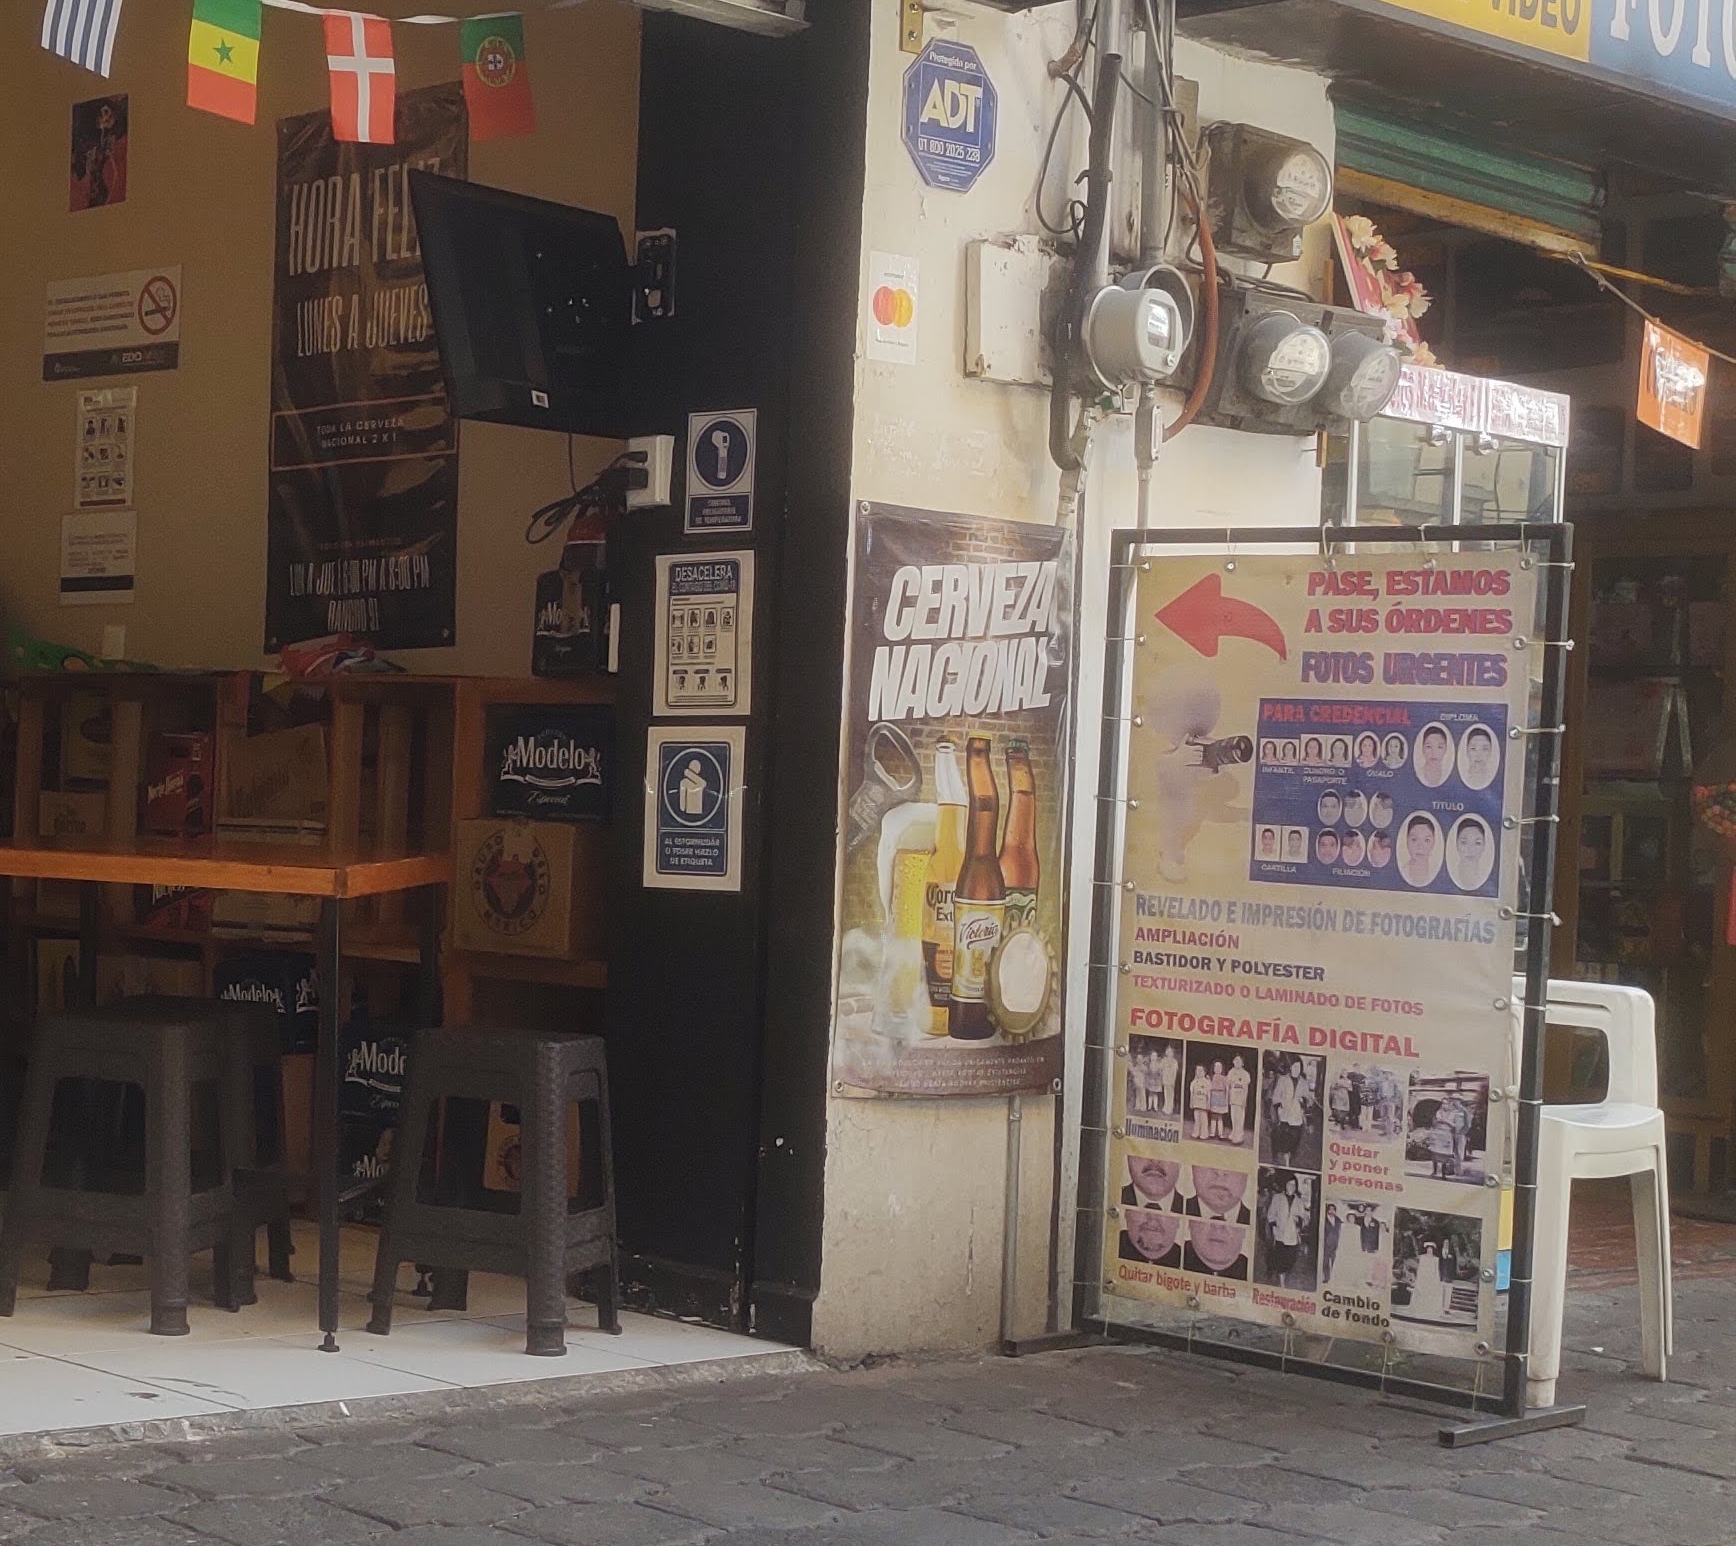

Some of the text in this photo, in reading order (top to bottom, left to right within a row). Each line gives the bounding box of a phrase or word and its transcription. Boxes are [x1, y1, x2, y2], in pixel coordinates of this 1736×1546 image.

[920, 77, 982, 133] ADT
[289, 156, 441, 277] HORA FEL
[297, 283, 429, 358] LUNES A JUEVES
[675, 564, 733, 581] DESACELERA
[1307, 569, 1511, 601] PASE, ESTAMOS
[883, 561, 1059, 642] CERVEZA
[1304, 602, 1513, 634] A SUS ÓRDENES
[868, 636, 1052, 722] NACIONAL
[1300, 651, 1508, 687] FOTOS URGENTES
[1264, 704, 1305, 723] PARA
[516, 736, 585, 771] Modelo
[1135, 893, 1496, 945] REVELADO E IMPRESIÓN DE FOTOGRAFÍAS
[1134, 926, 1240, 950] AMPLIACIÓN
[1133, 950, 1325, 982] BASTIDOR Y POLYESTER
[1132, 974, 1424, 1016] TEXTURIZADO O LAMINADO DE FOTOS
[1129, 1007, 1419, 1058] FOTOGRAFÍA DIGITAL
[1329, 1142, 1380, 1159] Quitar
[1327, 1173, 1404, 1193] personas
[1329, 1158, 1391, 1178] y poner
[1118, 1264, 1236, 1299] Quitar bigote y barba
[1321, 1306, 1390, 1328] de fondo
[1323, 1290, 1381, 1312] Cambio
